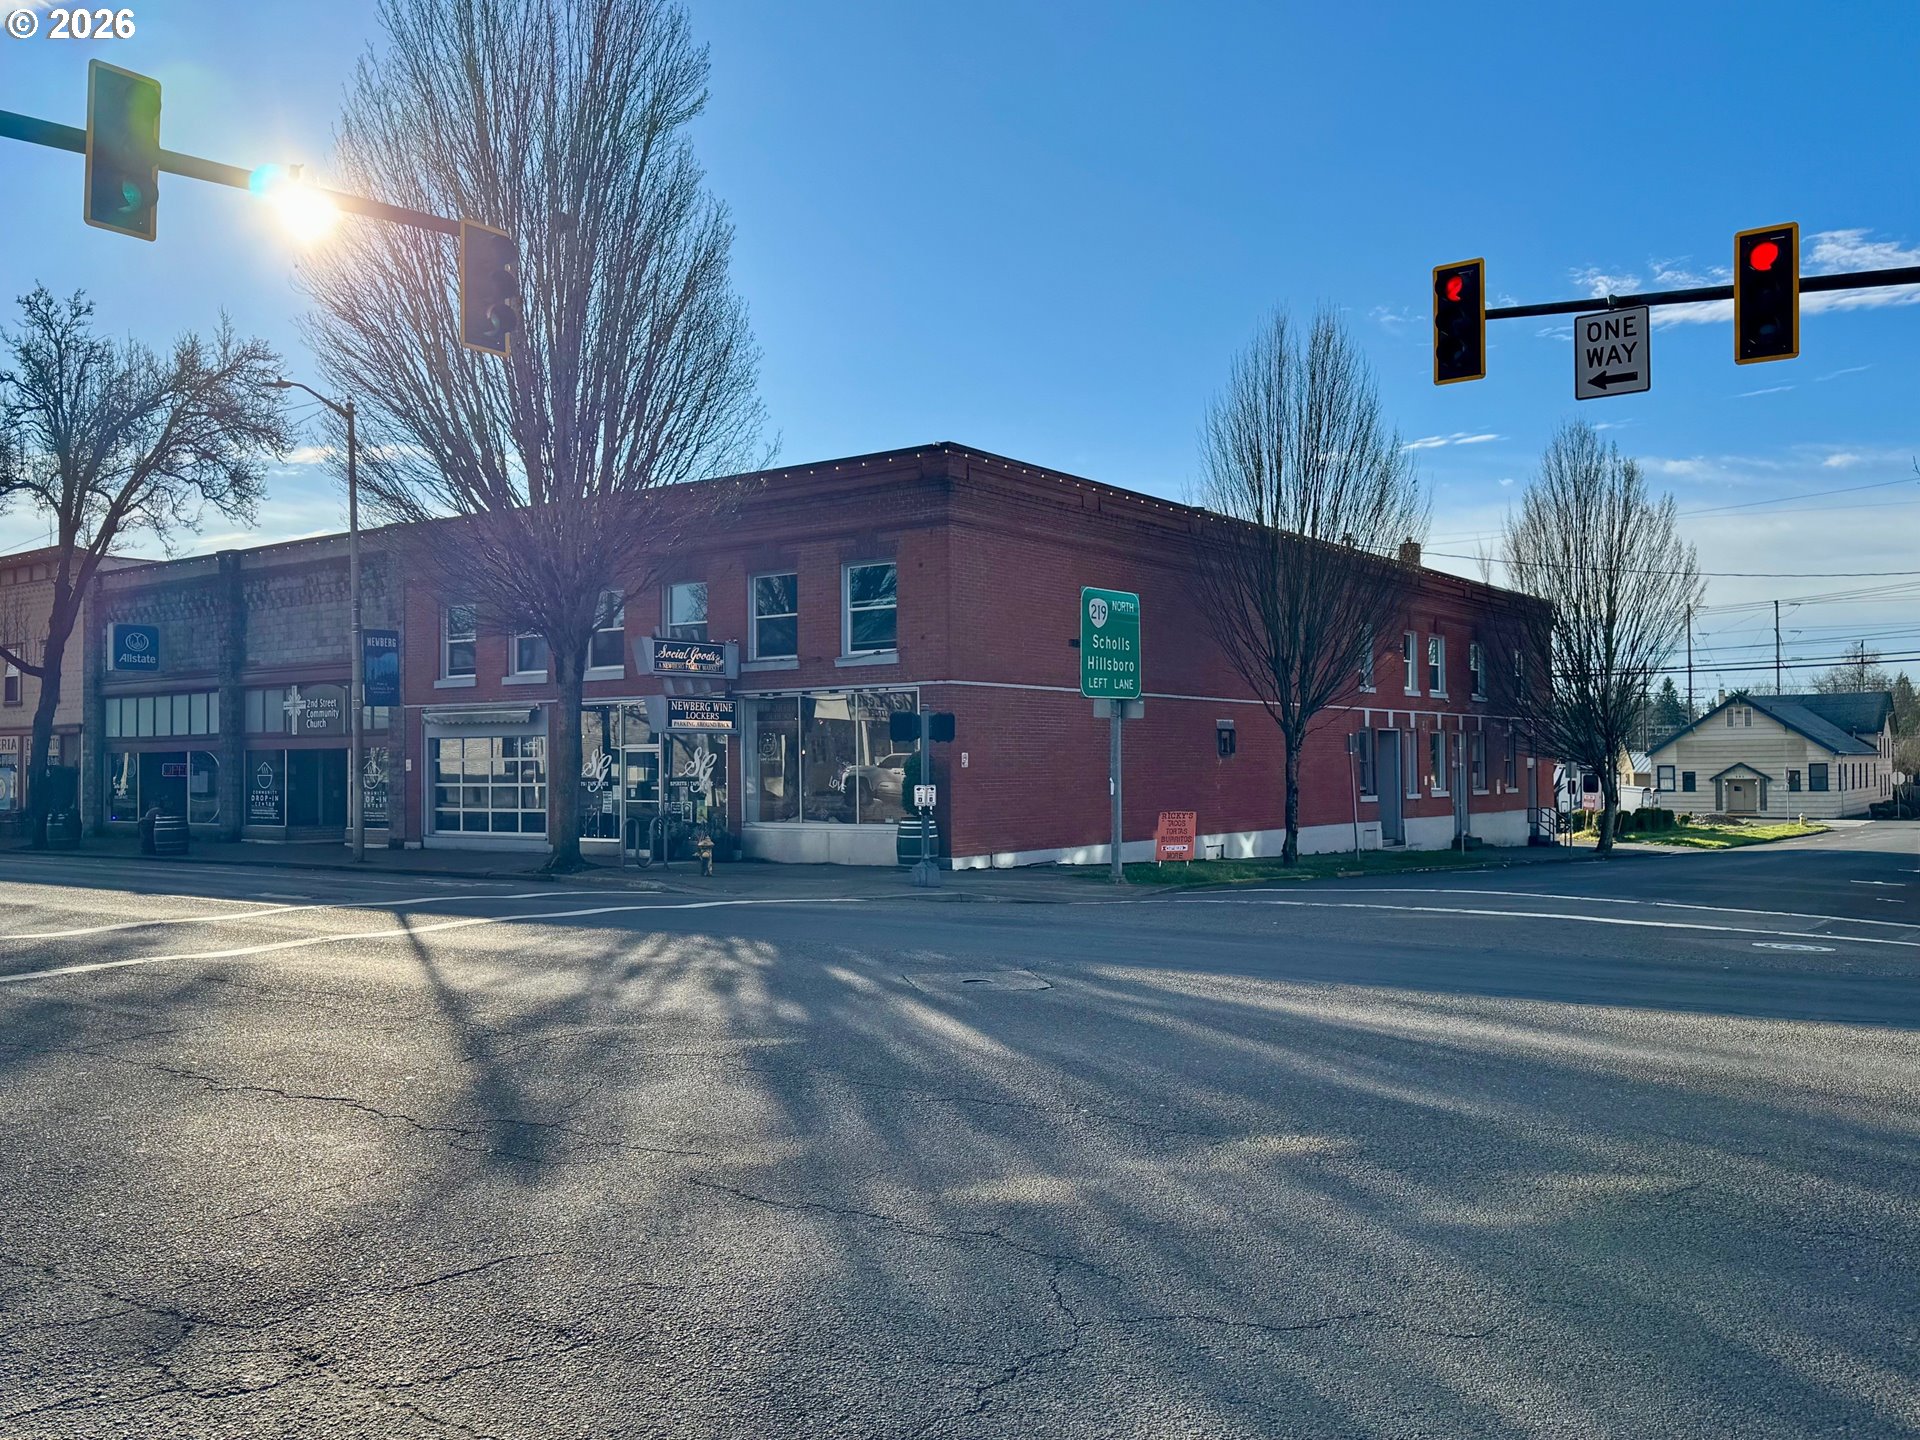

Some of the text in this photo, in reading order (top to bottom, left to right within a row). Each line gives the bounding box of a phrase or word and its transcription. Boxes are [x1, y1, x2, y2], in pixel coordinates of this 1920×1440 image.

[1587, 315, 1637, 342] ONE
[1586, 341, 1638, 368] WAY
[1091, 601, 1134, 620] 219 NORTH
[1092, 634, 1130, 651] Scholls
[119, 653, 156, 664] Allstate
[655, 644, 691, 659] Social
[686, 646, 717, 666] Goods
[1087, 656, 1135, 672] Hillsboro
[1088, 678, 1134, 690] LEFT LANE
[306, 699, 337, 708] 2nd Street
[671, 701, 733, 712] NEWBERG WINE
[306, 709, 340, 719] Community
[685, 712, 720, 720] LOCKERS
[306, 719, 327, 728] Church
[0, 738, 17, 751] RIA
[828, 776, 847, 793] LOVE
[1161, 812, 1194, 820] RICKY'S
